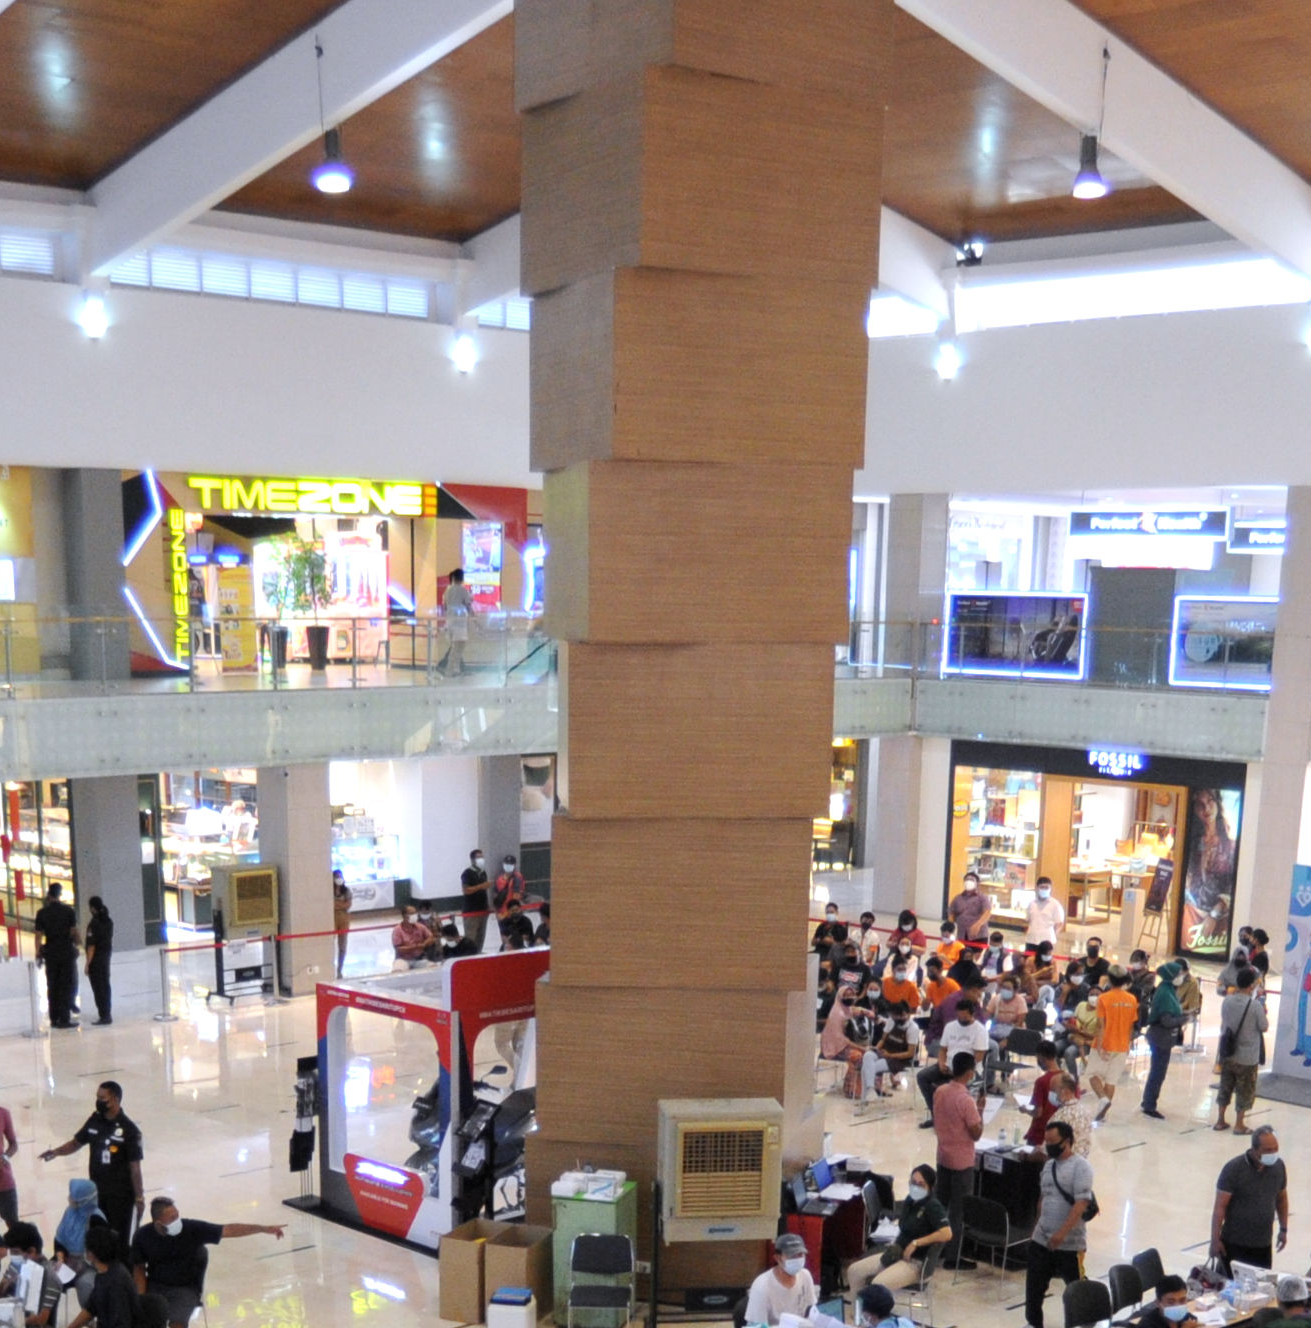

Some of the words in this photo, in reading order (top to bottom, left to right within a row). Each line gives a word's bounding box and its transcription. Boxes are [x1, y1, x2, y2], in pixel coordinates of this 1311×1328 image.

[188, 477, 423, 516] TIMEZONE
[1090, 516, 1139, 530] Perfect
[1156, 515, 1202, 531] Health
[168, 507, 191, 662] TIMEZONE
[1088, 751, 1142, 769] FOSSIL
